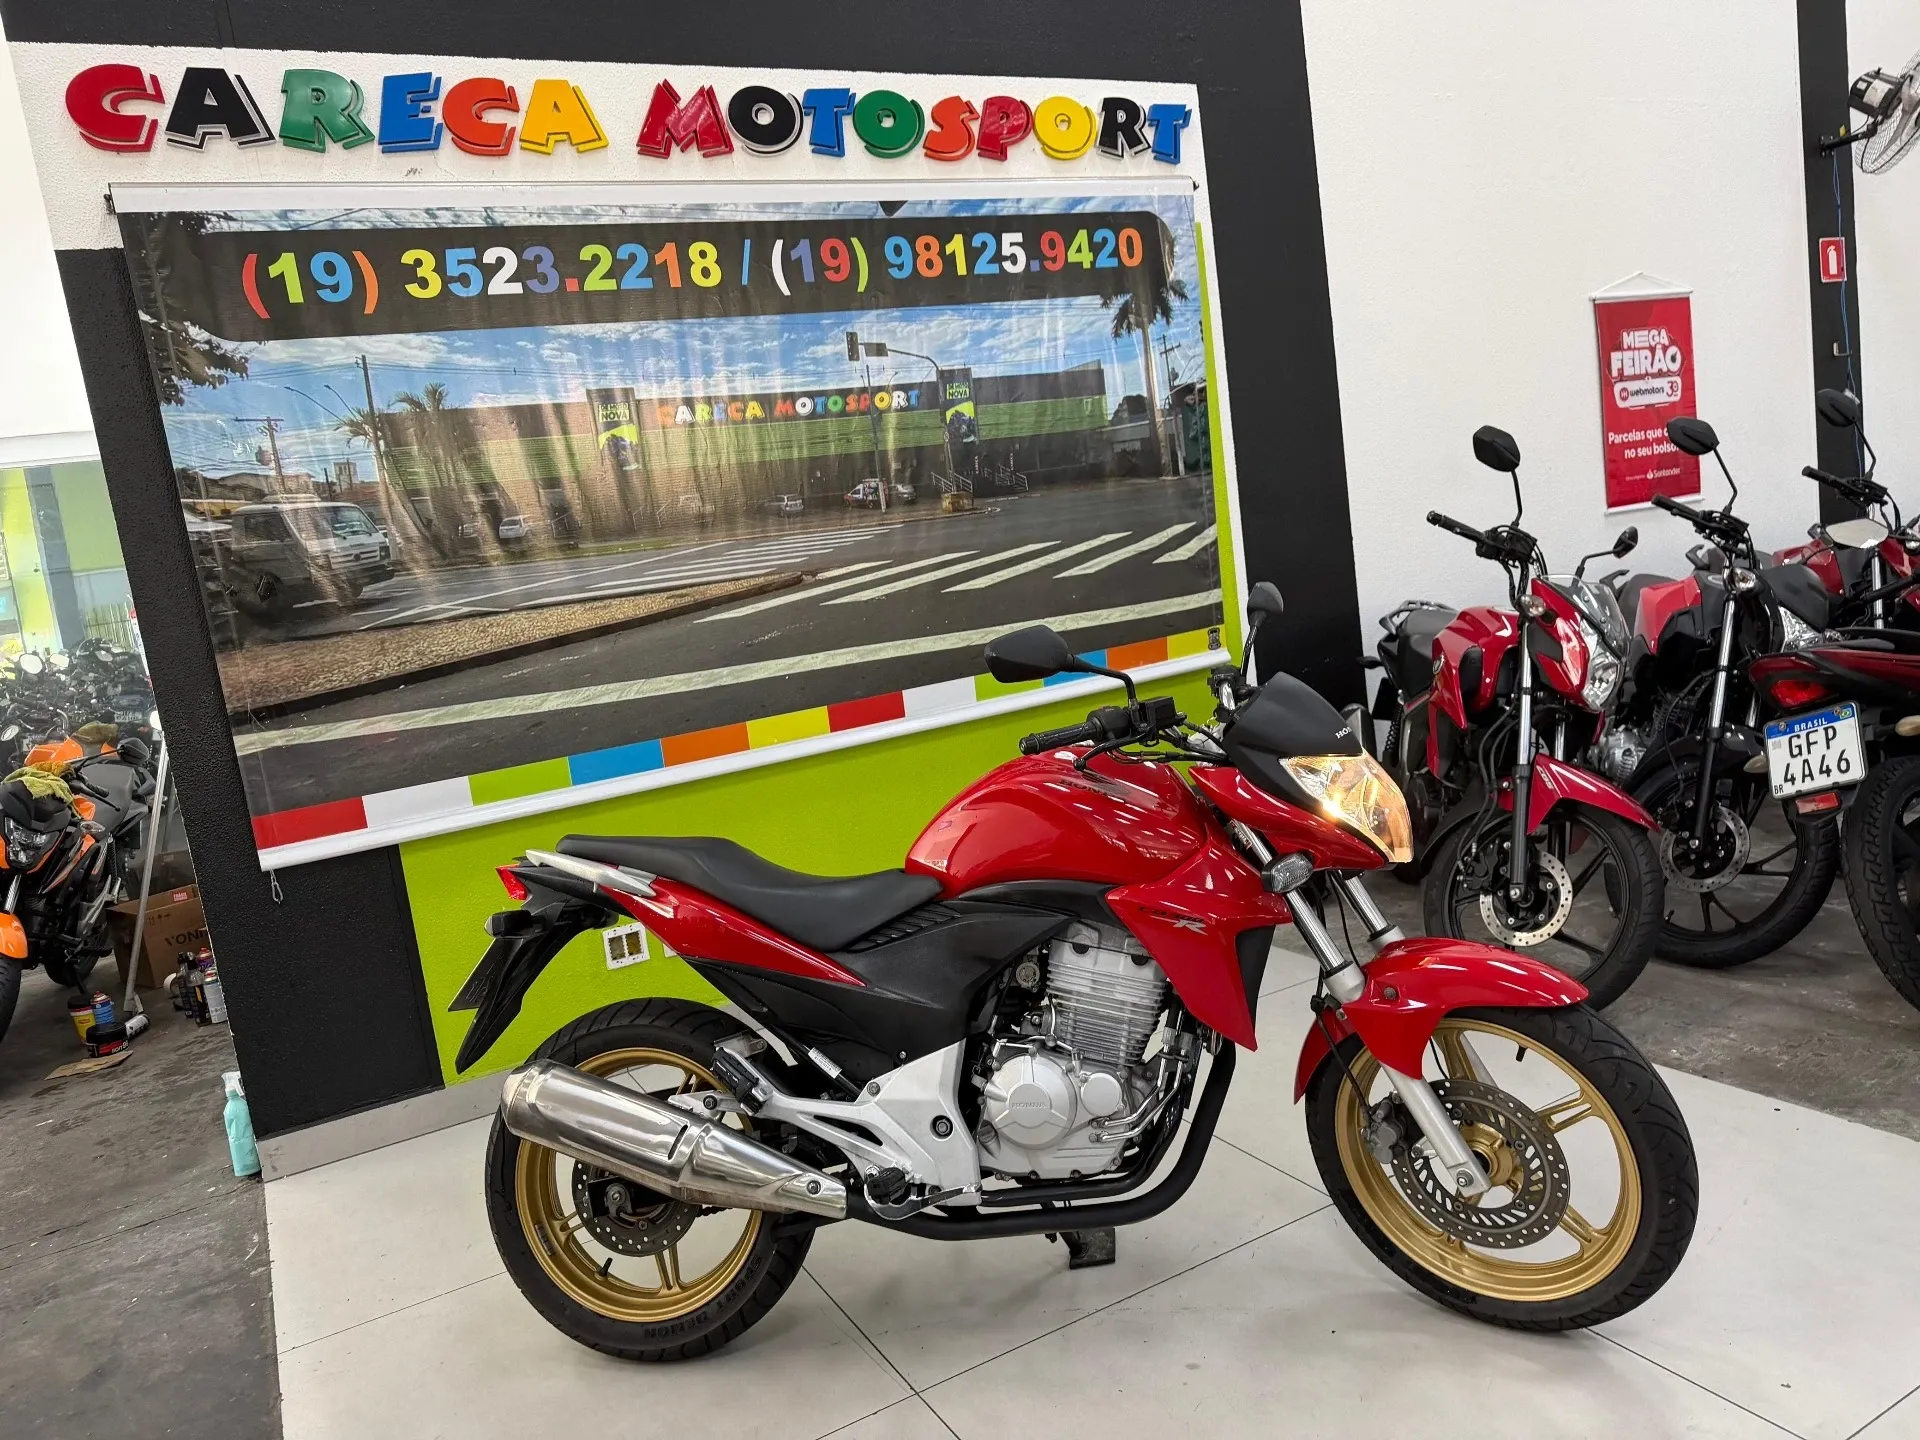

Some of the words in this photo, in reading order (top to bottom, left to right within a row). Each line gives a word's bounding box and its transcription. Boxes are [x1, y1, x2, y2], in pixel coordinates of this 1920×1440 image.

[65, 63, 609, 157] CARECA
[636, 79, 1191, 164] MOTOSPORT
[242, 250, 379, 319] (19)
[401, 241, 721, 299] 3523.2218
[741, 238, 751, 286] /
[771, 236, 869, 295] (19)
[885, 227, 1144, 279] 98125.9420
[1622, 328, 1669, 350] MEGA
[1610, 343, 1681, 378] FEIRÃO
[948, 389, 968, 399] NOVA
[1630, 386, 1665, 397] webmotors
[601, 410, 628, 421] NOVA
[658, 400, 766, 425] CARECA
[774, 389, 920, 417] MOTOSPORT
[1608, 428, 1645, 445] Parcelas
[1646, 428, 1662, 442] que
[1624, 448, 1636, 459] no
[1637, 445, 1652, 457] seu
[1653, 467, 1681, 478] Santander
[1794, 717, 1828, 732] BRASIL
[1788, 725, 1837, 758] GFP
[1783, 748, 1851, 786] 4A46
[1774, 784, 1784, 795] BR
